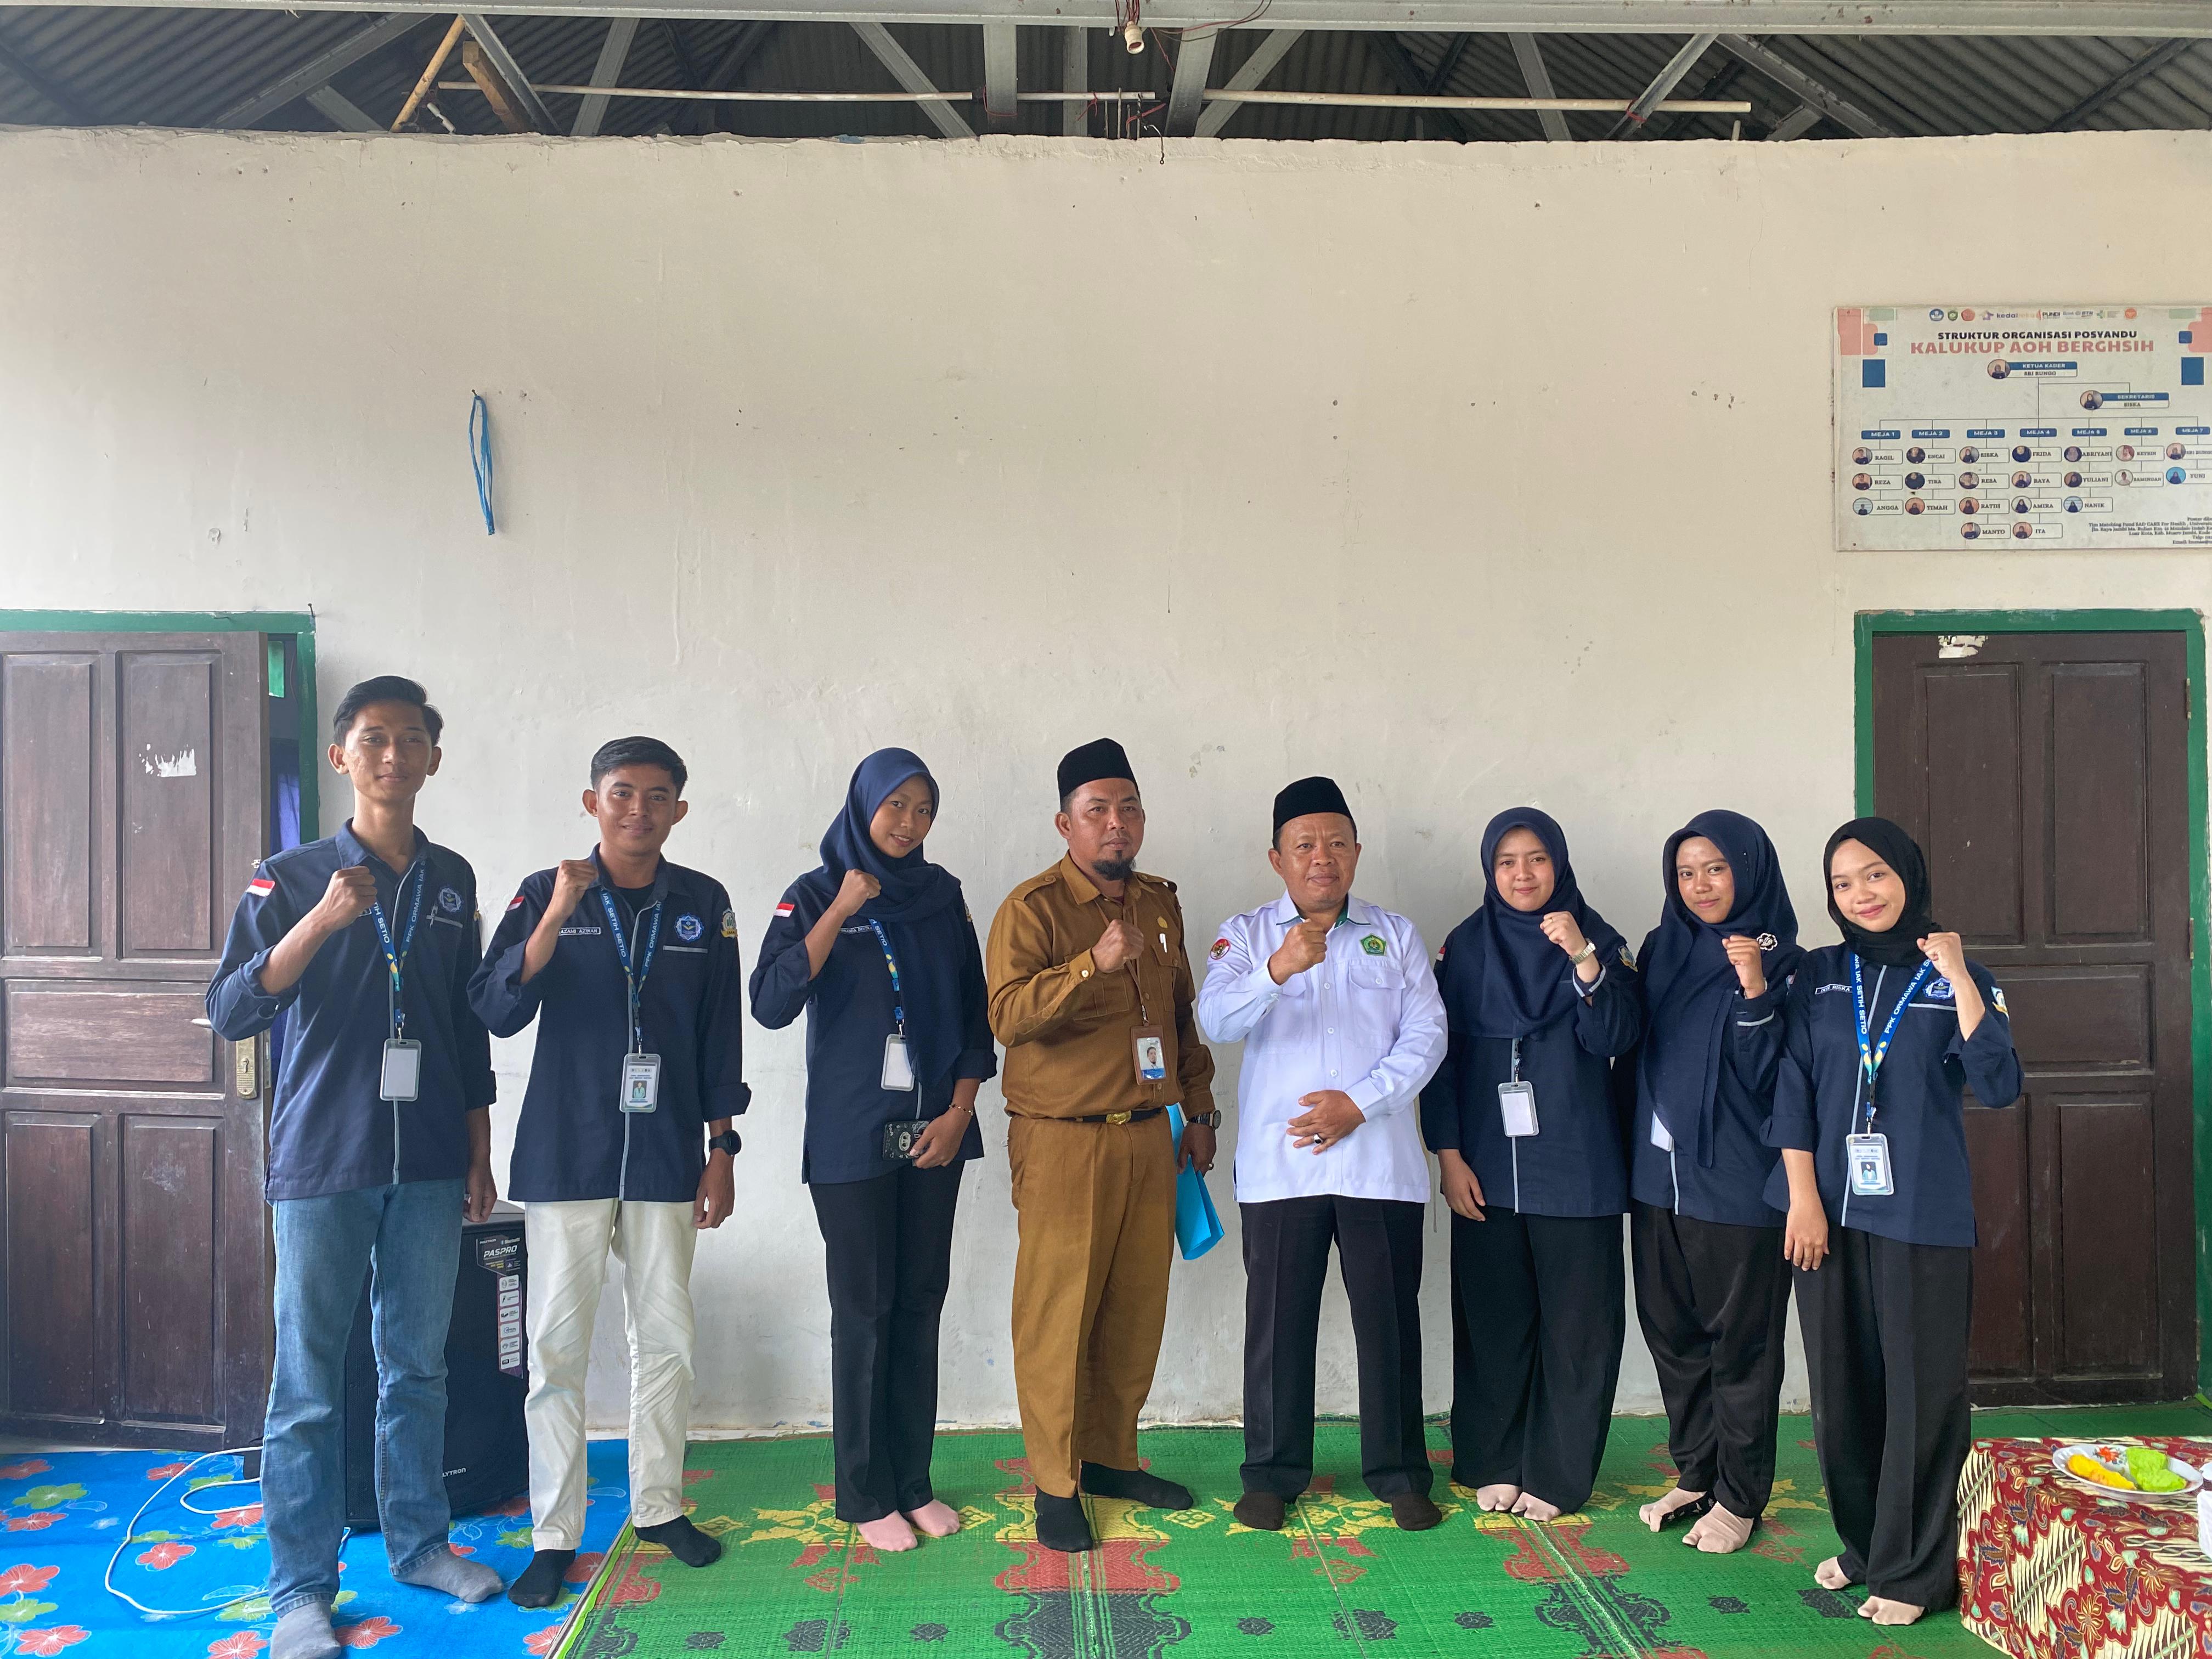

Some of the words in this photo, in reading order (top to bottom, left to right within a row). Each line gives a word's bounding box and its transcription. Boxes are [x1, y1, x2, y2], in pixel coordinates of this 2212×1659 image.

[1911, 341, 2005, 354] KALUKUP
[2010, 341, 2051, 353] AOH
[2057, 340, 2154, 353] BERGHSIH
[1938, 331, 1999, 340] STRUKTUR
[2002, 331, 2072, 339] ORGANISASI
[2075, 330, 2137, 338] POSYANDU
[406, 924, 415, 943] PPK
[411, 884, 422, 922] ORMAWA
[602, 893, 611, 905] IAK
[607, 907, 619, 930] SETIH
[616, 933, 627, 957] SETIO
[377, 917, 390, 943] SETIO
[649, 913, 660, 949] ORMAWA
[875, 926, 888, 946] SETIO
[1884, 1016, 1896, 1034] PPK
[1893, 981, 1917, 1015] ORMAWA
[1915, 968, 1926, 980] IAK
[1859, 1009, 1867, 1034] SETIO
[483, 1245, 517, 1258] PASPRO
[442, 1468, 466, 1477] LYTRON
